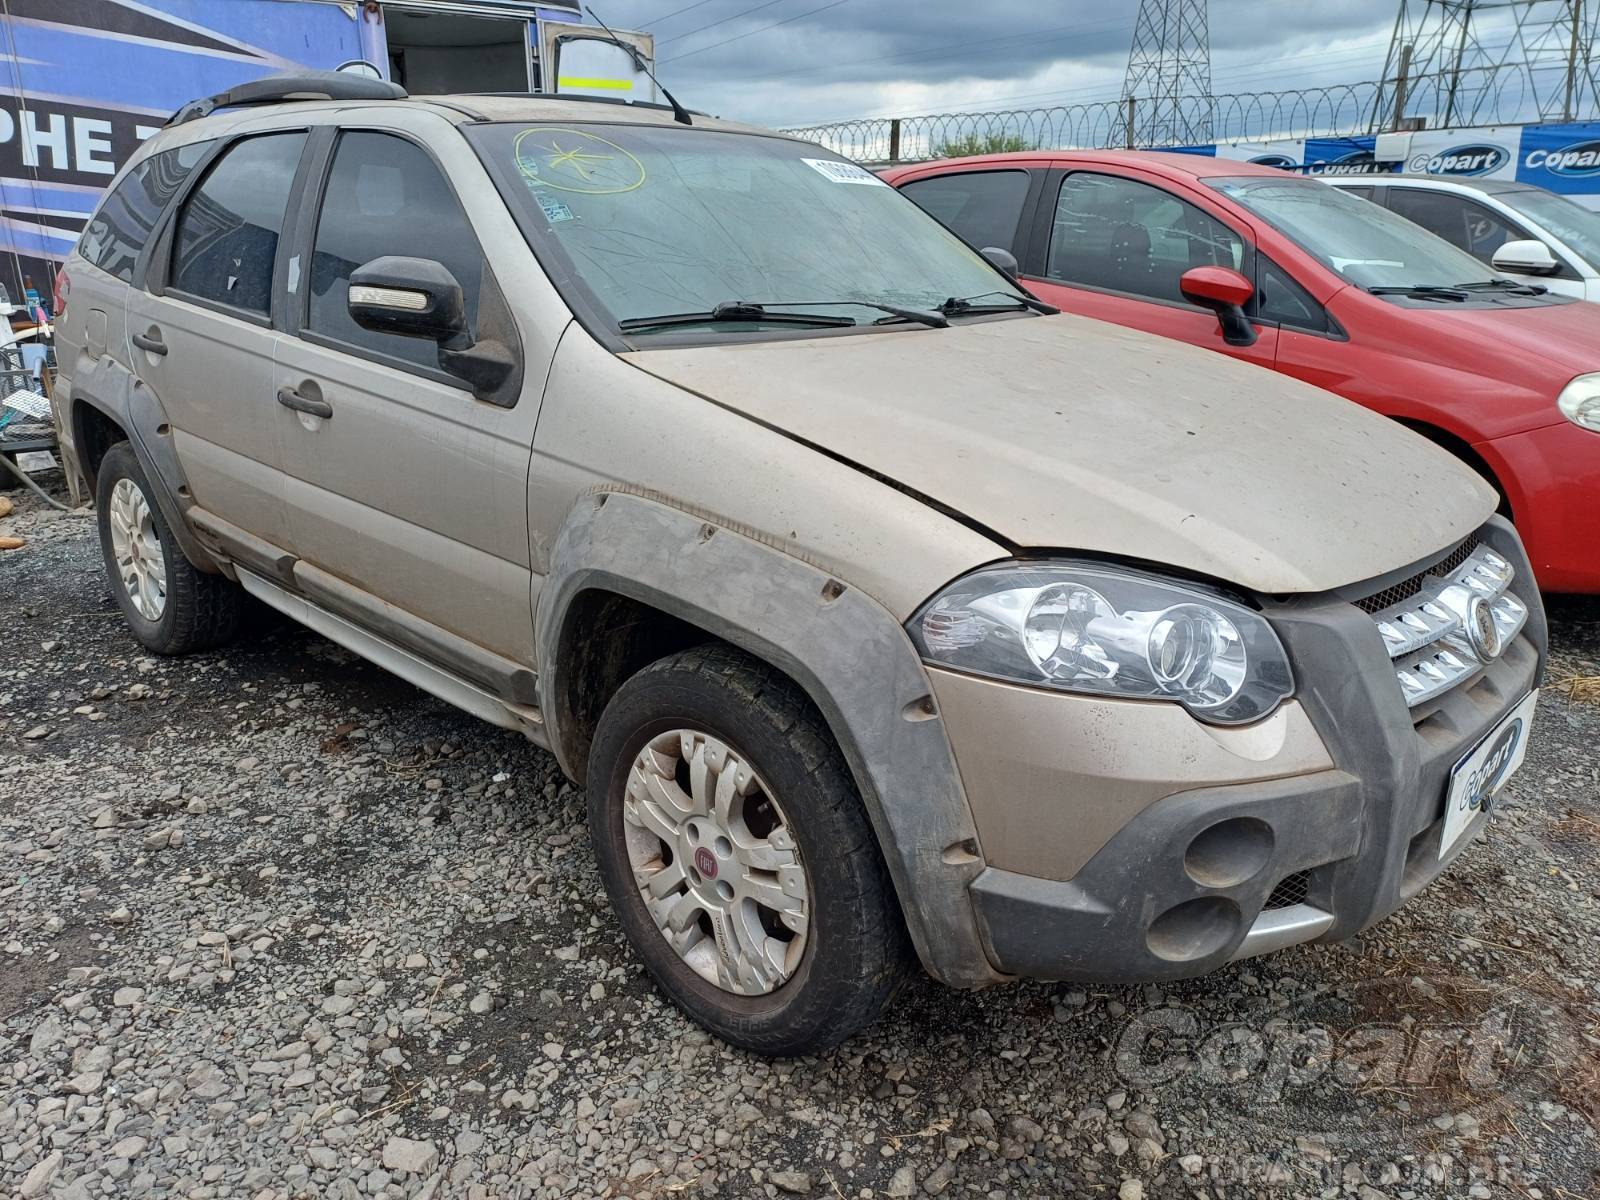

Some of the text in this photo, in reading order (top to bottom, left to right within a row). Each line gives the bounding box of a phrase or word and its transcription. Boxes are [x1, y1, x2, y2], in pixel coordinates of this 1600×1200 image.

[1409, 149, 1498, 174] Copart
[1525, 149, 1600, 171] Copa
[1460, 728, 1515, 811] Copart
